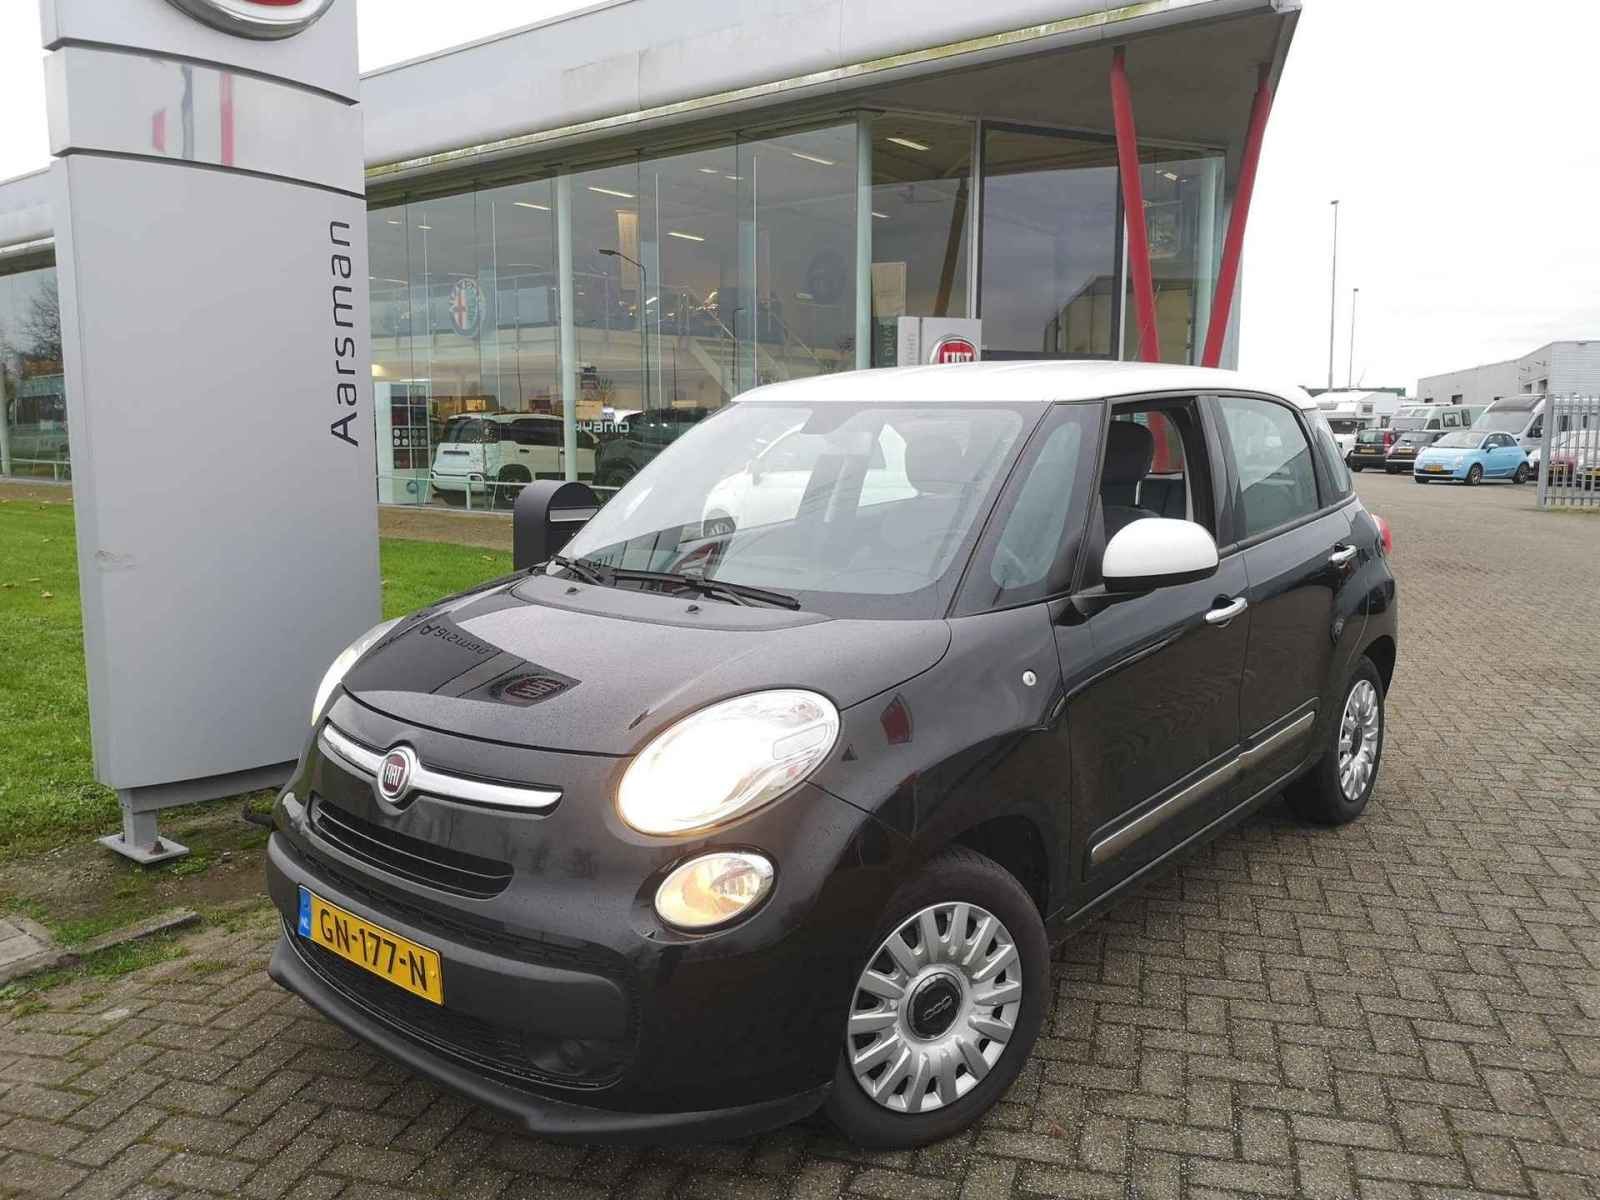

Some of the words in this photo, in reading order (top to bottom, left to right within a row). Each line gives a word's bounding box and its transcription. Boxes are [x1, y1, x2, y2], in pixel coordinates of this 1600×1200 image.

[330, 221, 359, 447] Aarsman
[384, 763, 404, 786] FIAT
[319, 908, 428, 992] GN-177-N
